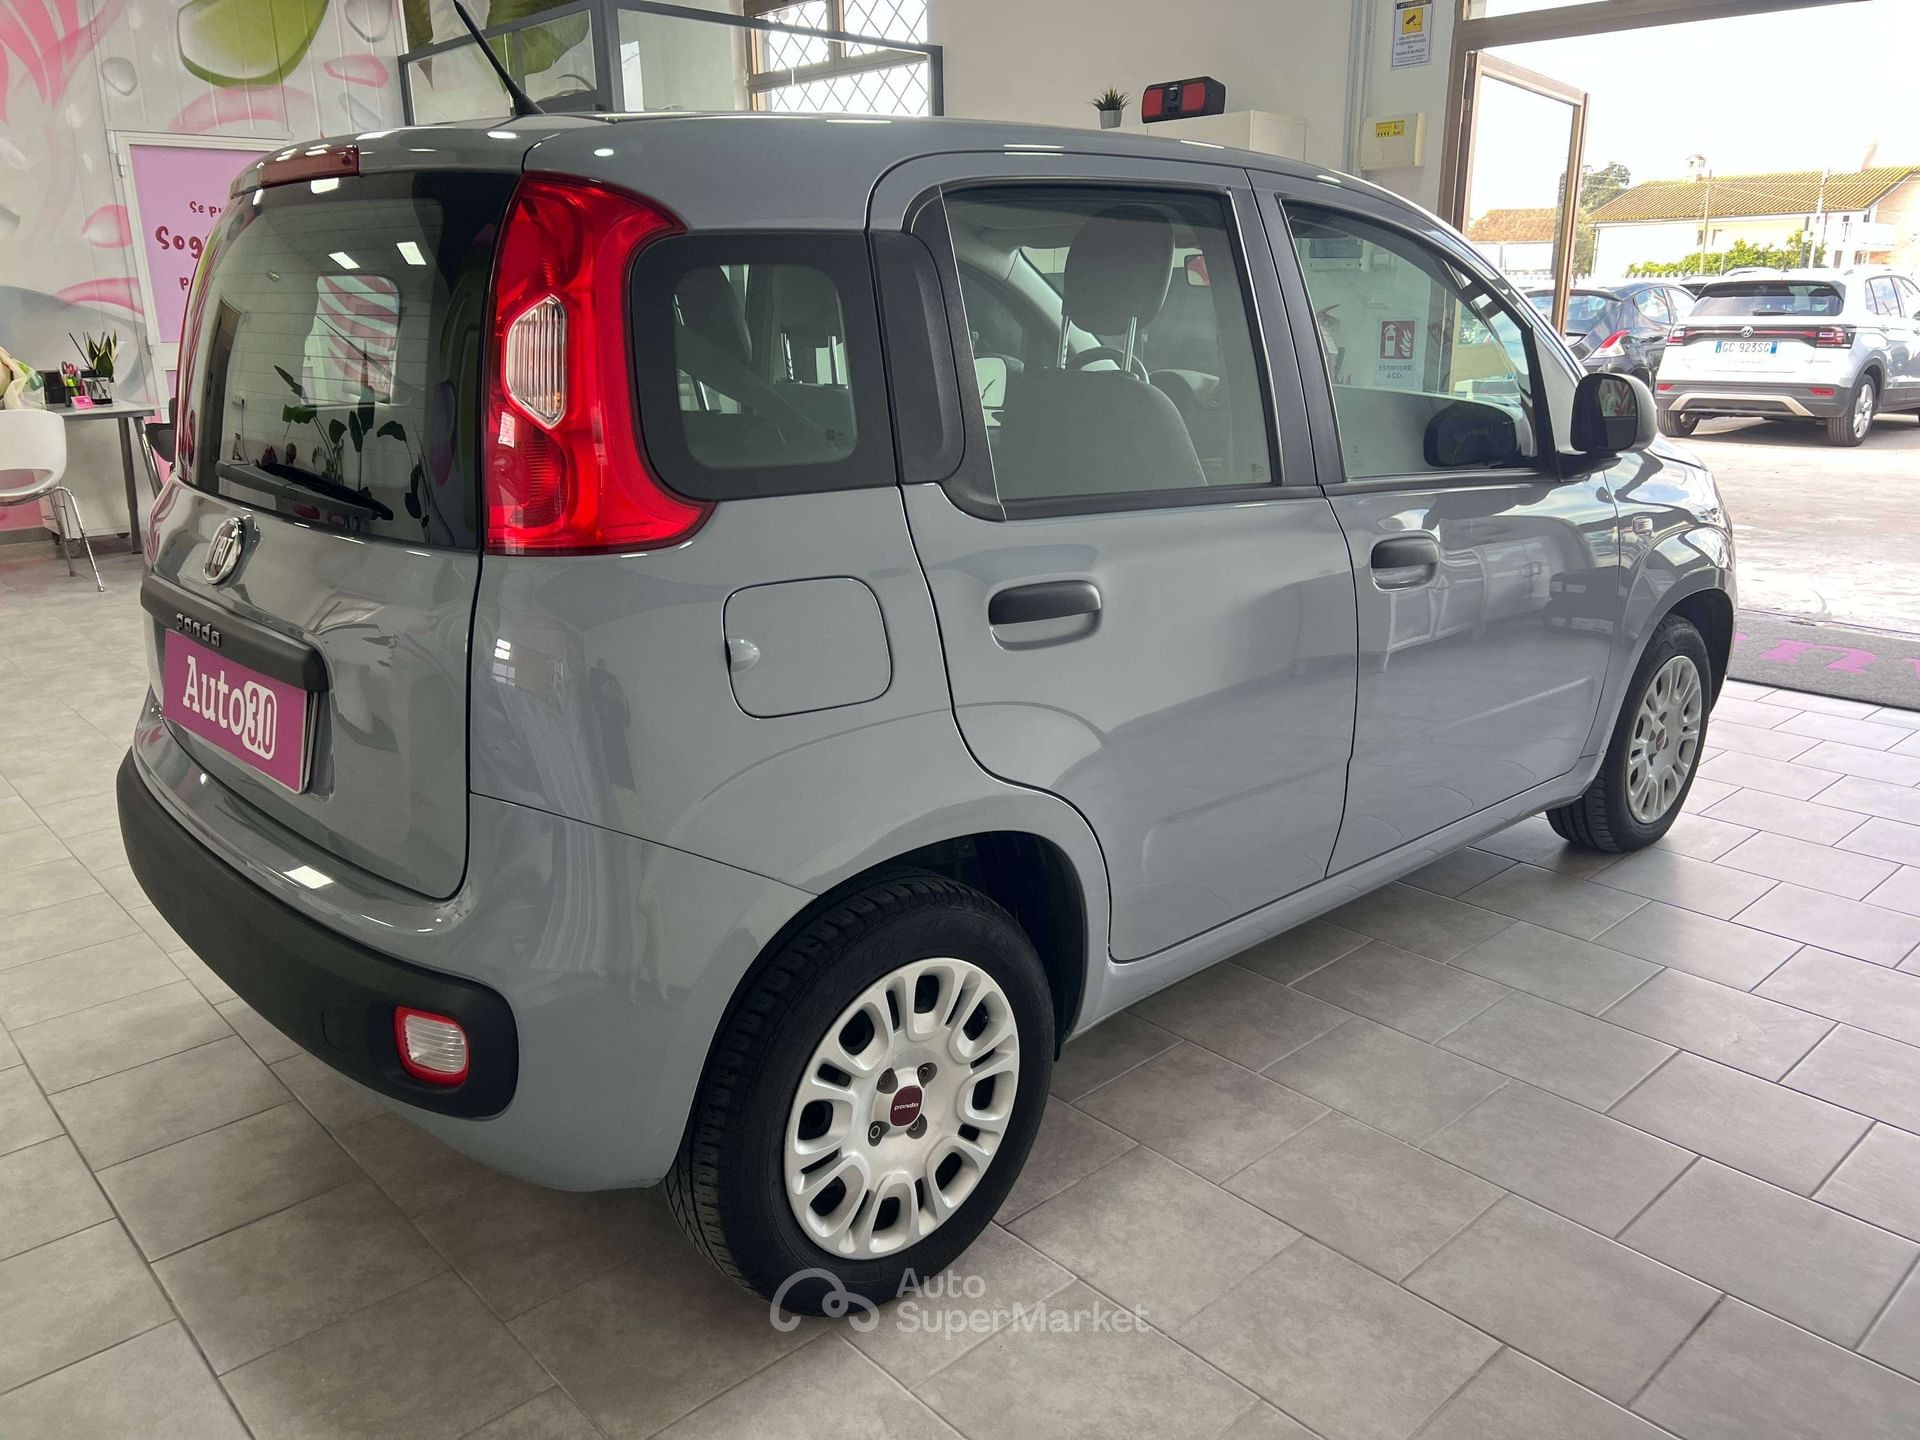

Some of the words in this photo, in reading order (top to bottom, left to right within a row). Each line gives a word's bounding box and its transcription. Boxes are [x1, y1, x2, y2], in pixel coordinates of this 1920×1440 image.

[189, 200, 205, 213] Se
[155, 225, 209, 259] Sog
[175, 612, 222, 648] panda
[894, 1102, 919, 1111] panda
